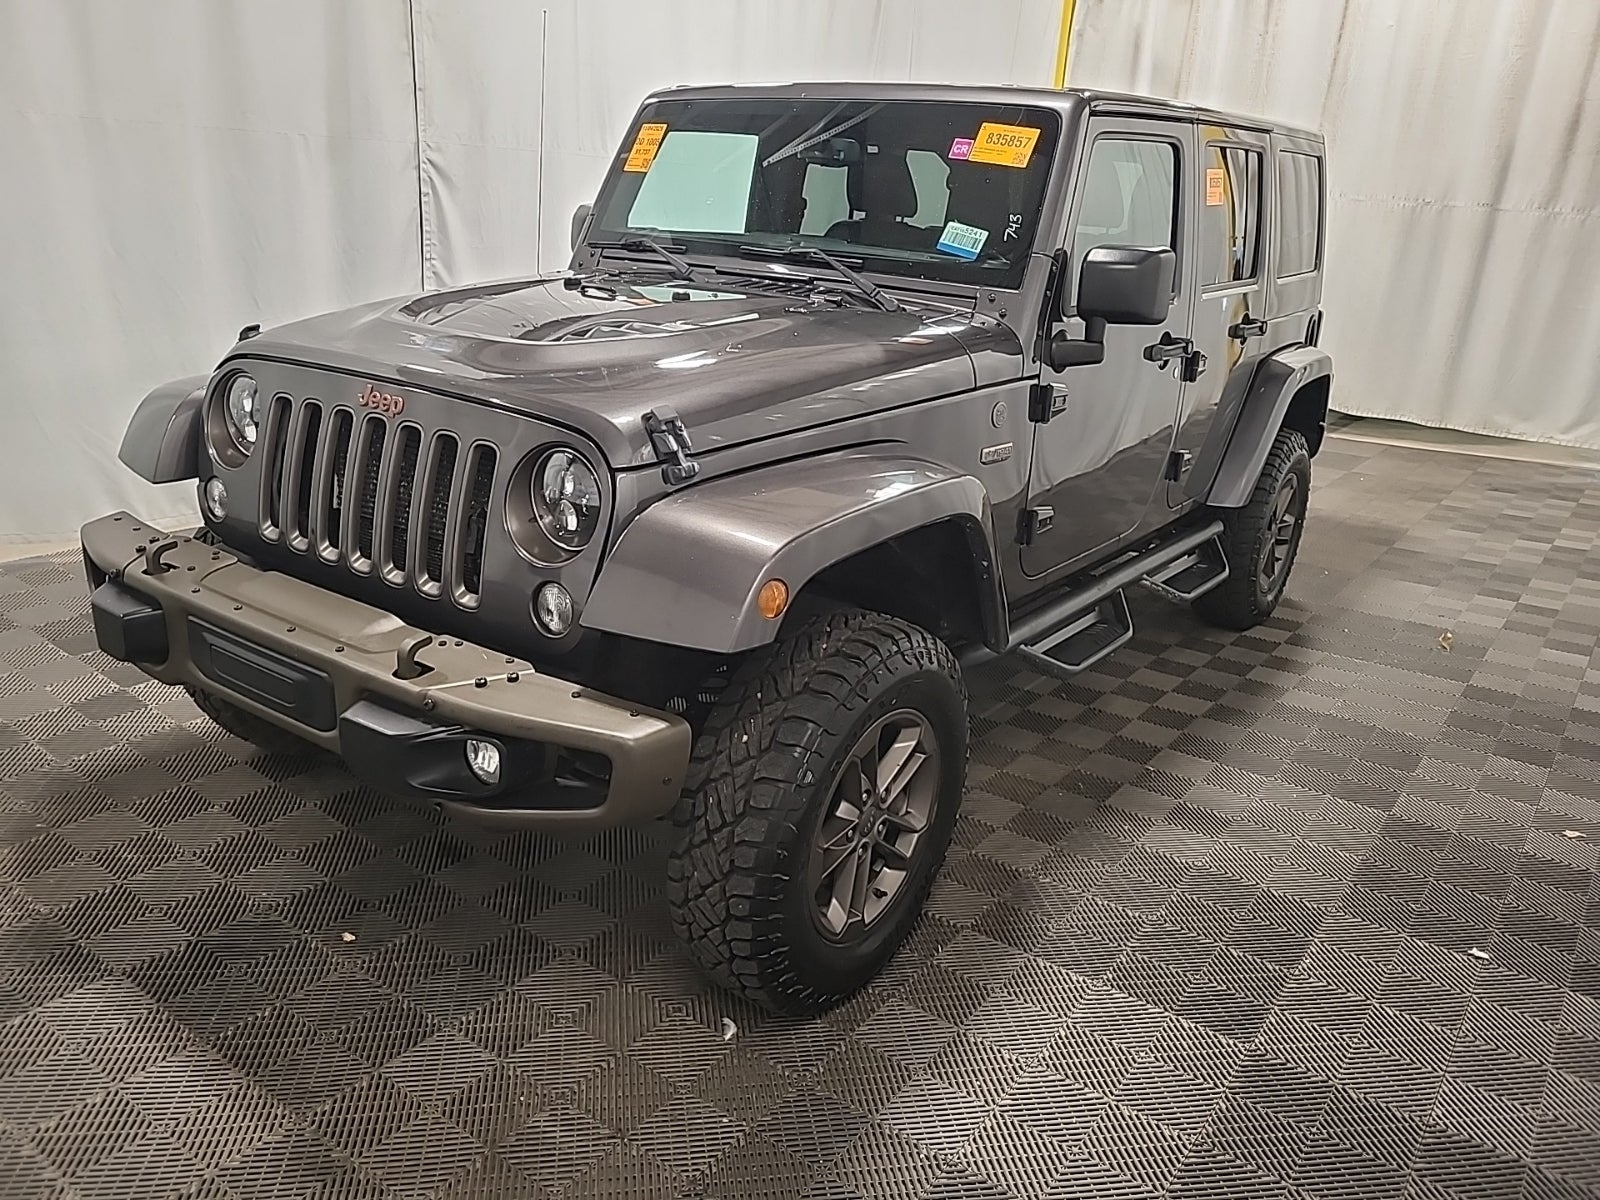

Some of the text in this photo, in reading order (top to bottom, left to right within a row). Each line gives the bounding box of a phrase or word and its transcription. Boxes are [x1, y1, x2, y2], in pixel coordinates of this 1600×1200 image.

[953, 144, 969, 154] CR
[985, 132, 1032, 149] 835857
[1003, 213, 1023, 242] 743
[357, 383, 404, 418] Jeep
